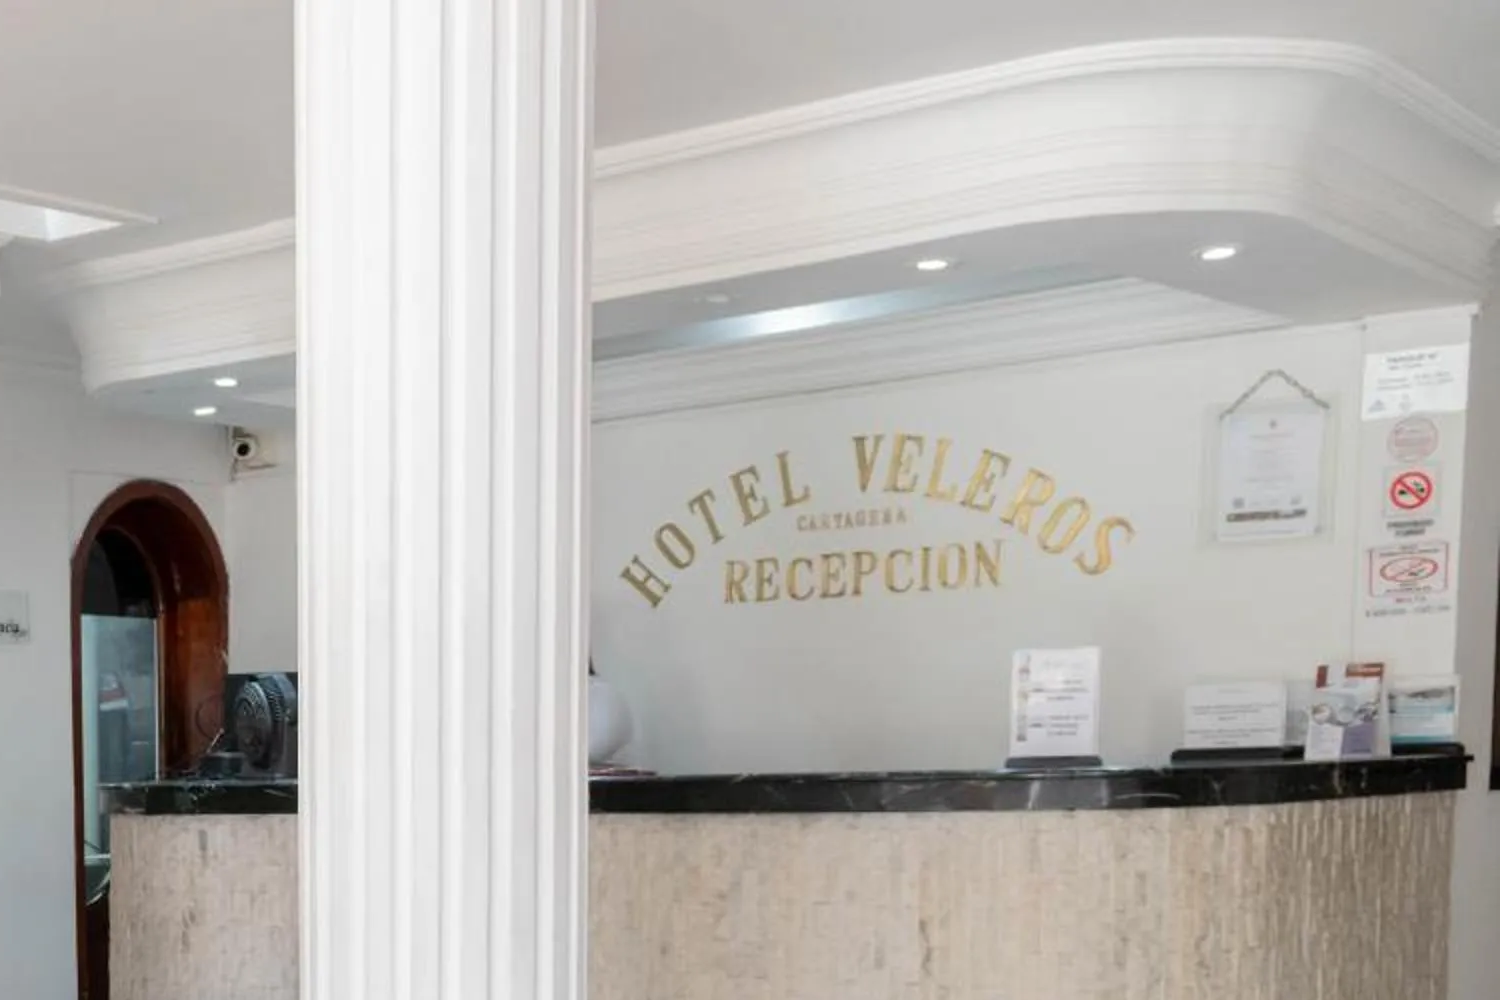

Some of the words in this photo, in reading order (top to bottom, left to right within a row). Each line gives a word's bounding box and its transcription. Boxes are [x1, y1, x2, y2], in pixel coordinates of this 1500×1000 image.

[619, 450, 812, 608] HOTEL
[851, 433, 1137, 578] VELEROS
[796, 507, 908, 532] CARTAGENA
[723, 539, 1006, 604] RECEPCION
